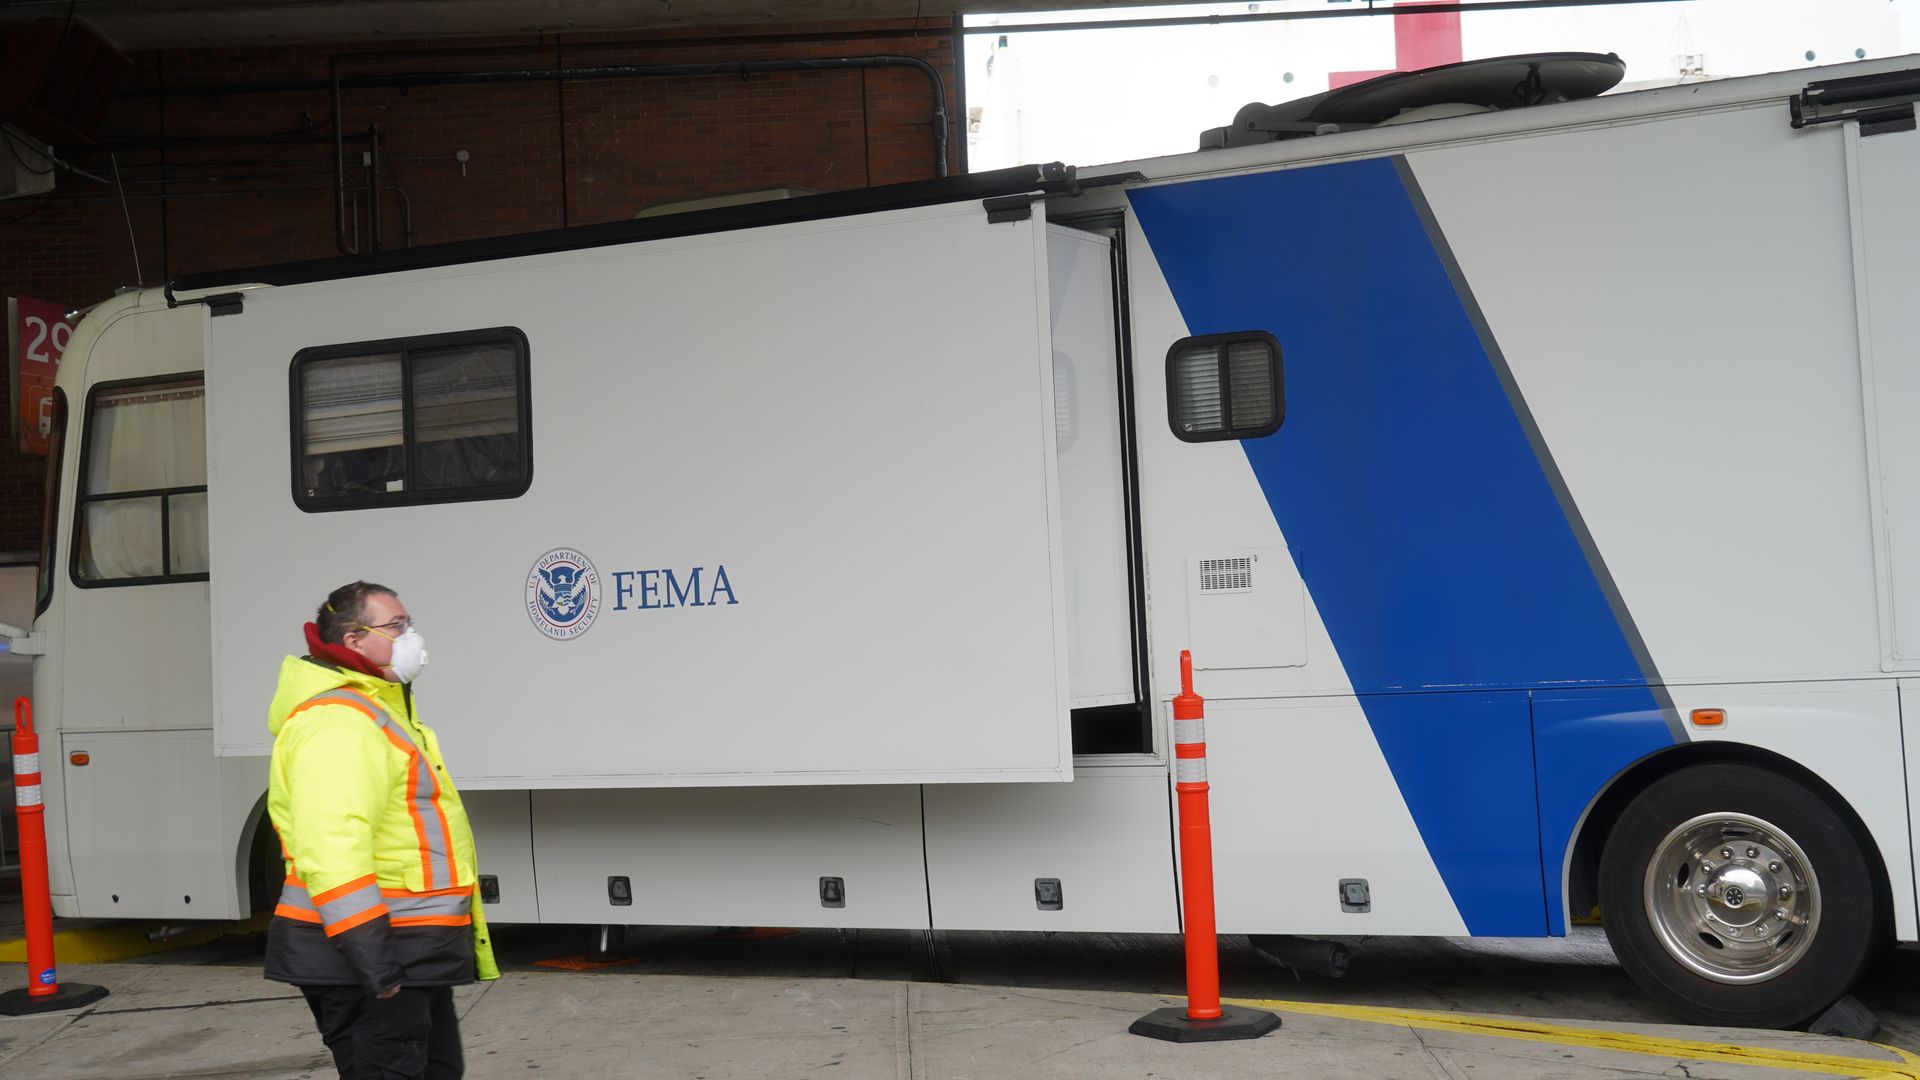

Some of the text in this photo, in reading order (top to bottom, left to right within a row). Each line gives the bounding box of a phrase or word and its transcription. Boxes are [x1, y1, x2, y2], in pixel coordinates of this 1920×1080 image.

[25, 316, 73, 364] 29
[540, 552, 590, 573] DEPARTMENT
[589, 574, 597, 586] OF
[612, 565, 739, 610] FEMA
[529, 597, 598, 636] HOMELAND SECURITY
